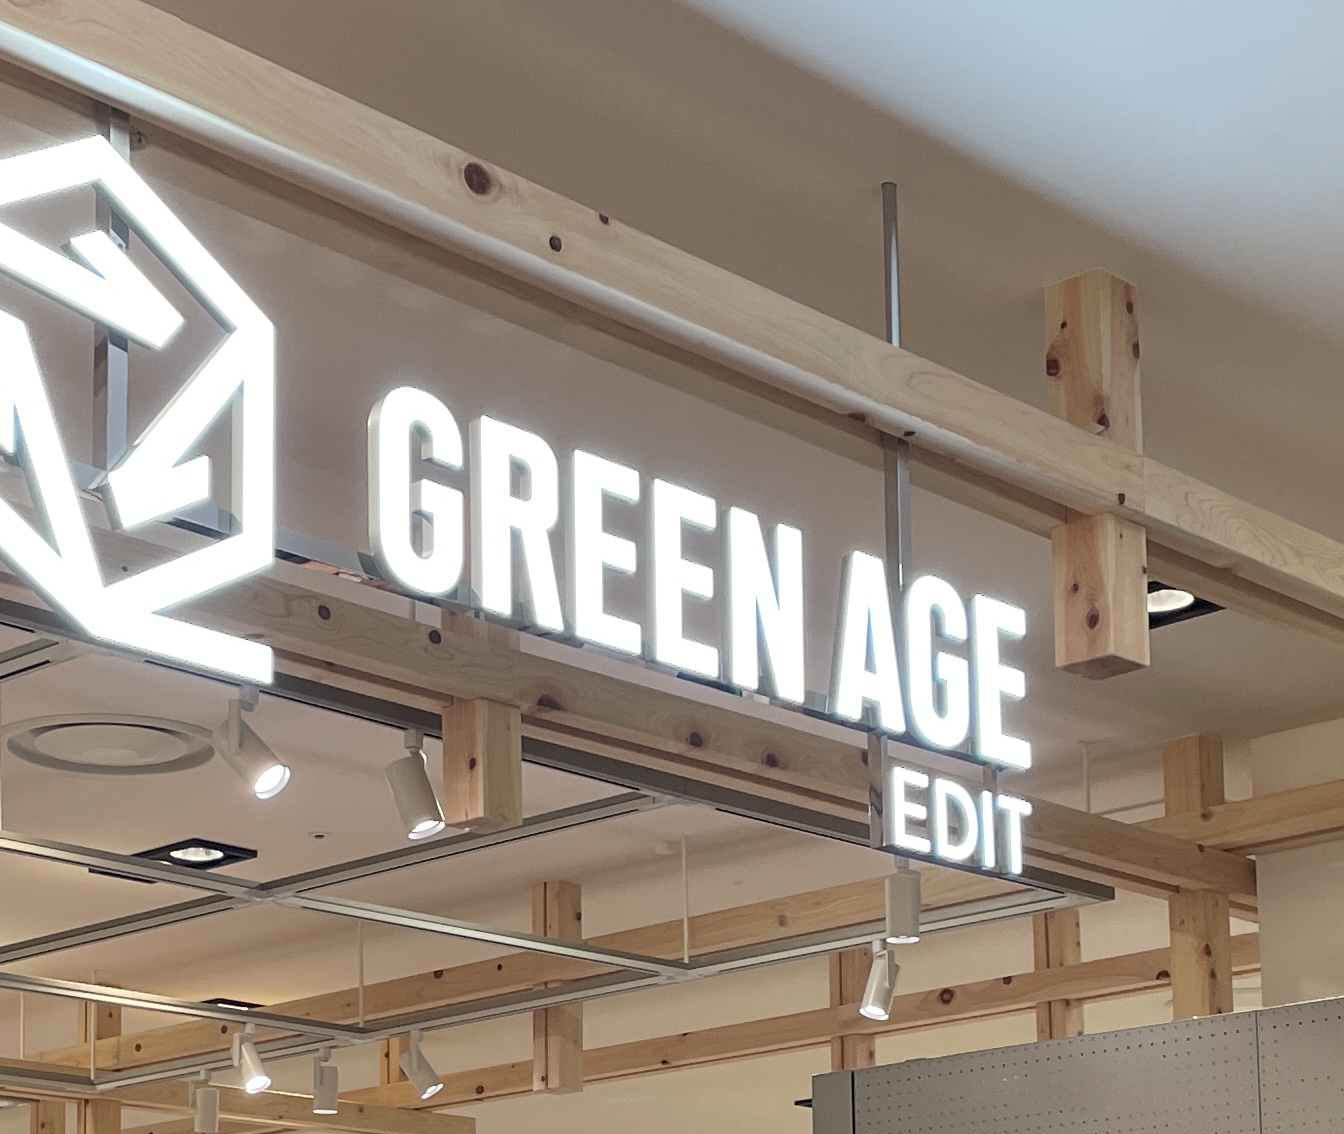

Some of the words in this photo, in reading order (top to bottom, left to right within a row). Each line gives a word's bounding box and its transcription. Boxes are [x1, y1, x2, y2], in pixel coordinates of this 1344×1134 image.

[367, 386, 803, 704] GREEN
[832, 549, 1032, 770] AGE
[888, 765, 1032, 876] EDIT
